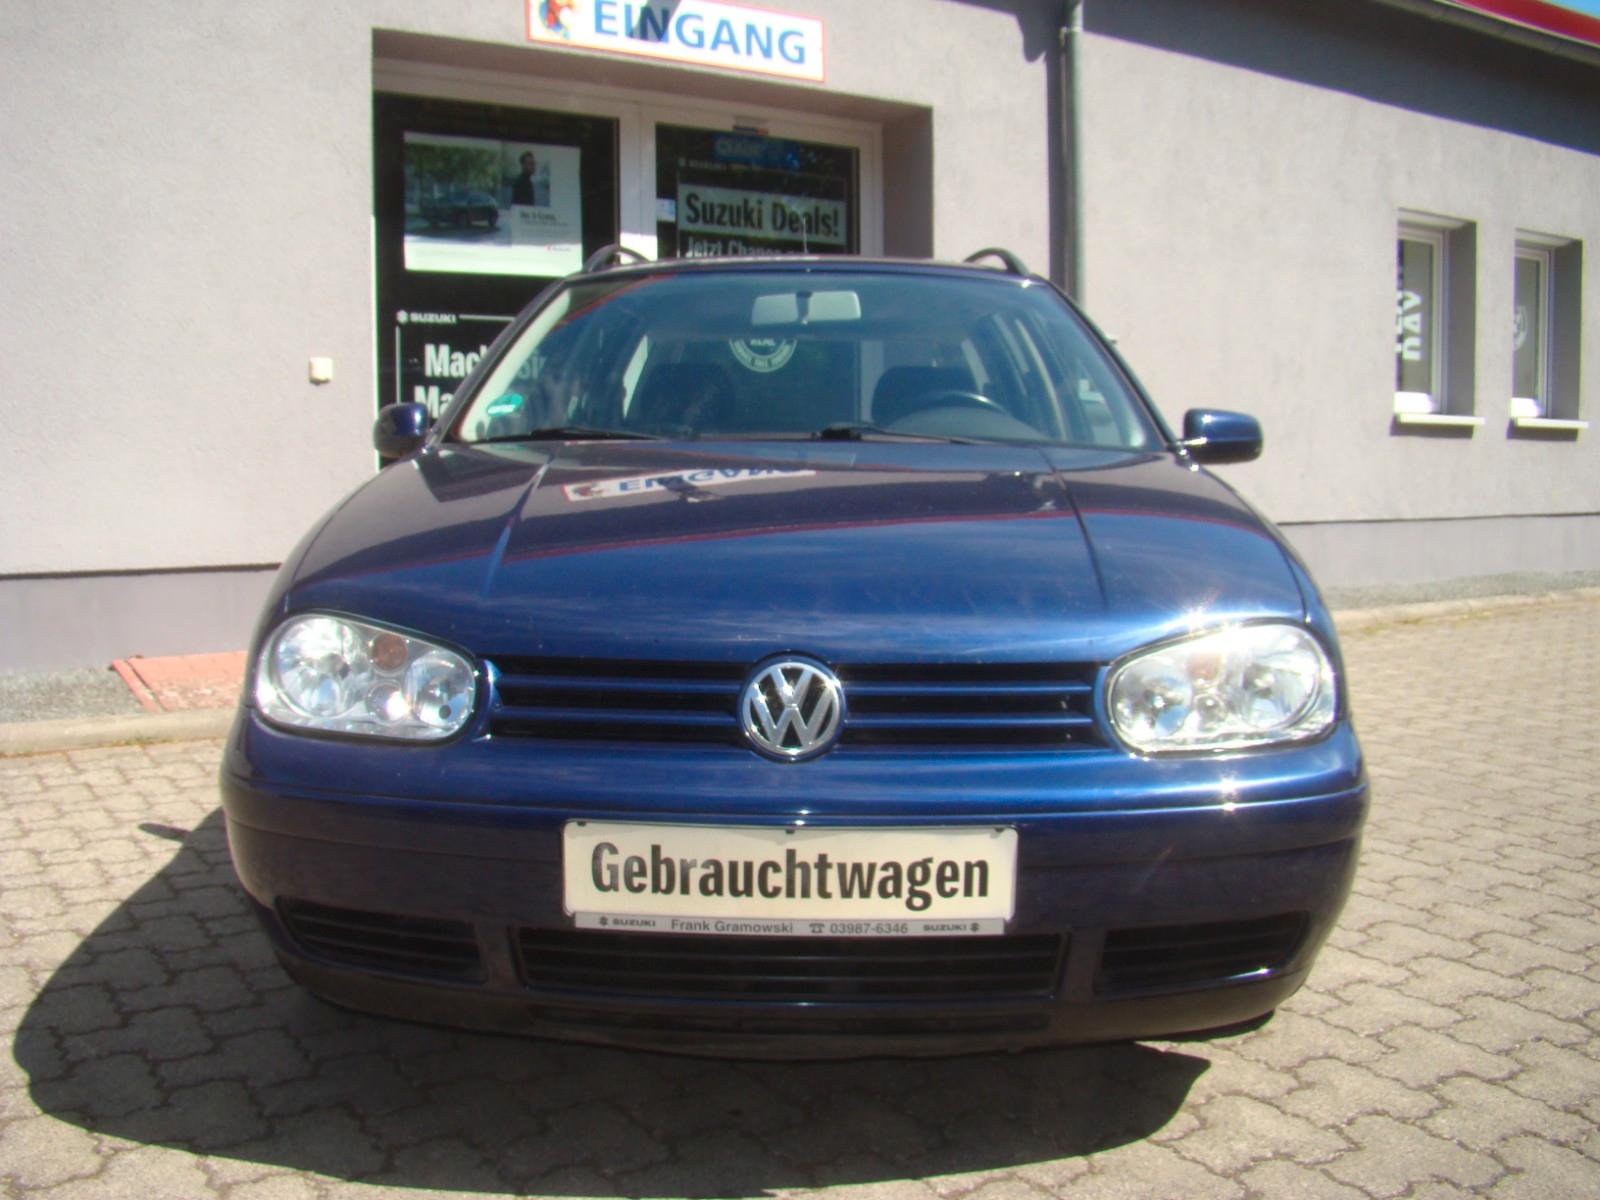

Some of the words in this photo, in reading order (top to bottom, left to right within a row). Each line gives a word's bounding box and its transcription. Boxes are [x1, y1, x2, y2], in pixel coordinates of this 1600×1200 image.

[593, 0, 806, 64] EINGANG
[686, 193, 764, 230] Suzuki
[771, 202, 839, 237] Deals!
[424, 343, 488, 378] Mac
[591, 842, 989, 912] Gebrauchtwagen
[612, 918, 656, 927] SUZUKI
[671, 918, 710, 932] Frank
[714, 920, 793, 934] Gramowski
[830, 922, 908, 934] 03987-6346
[923, 923, 966, 932] SUZUKI
